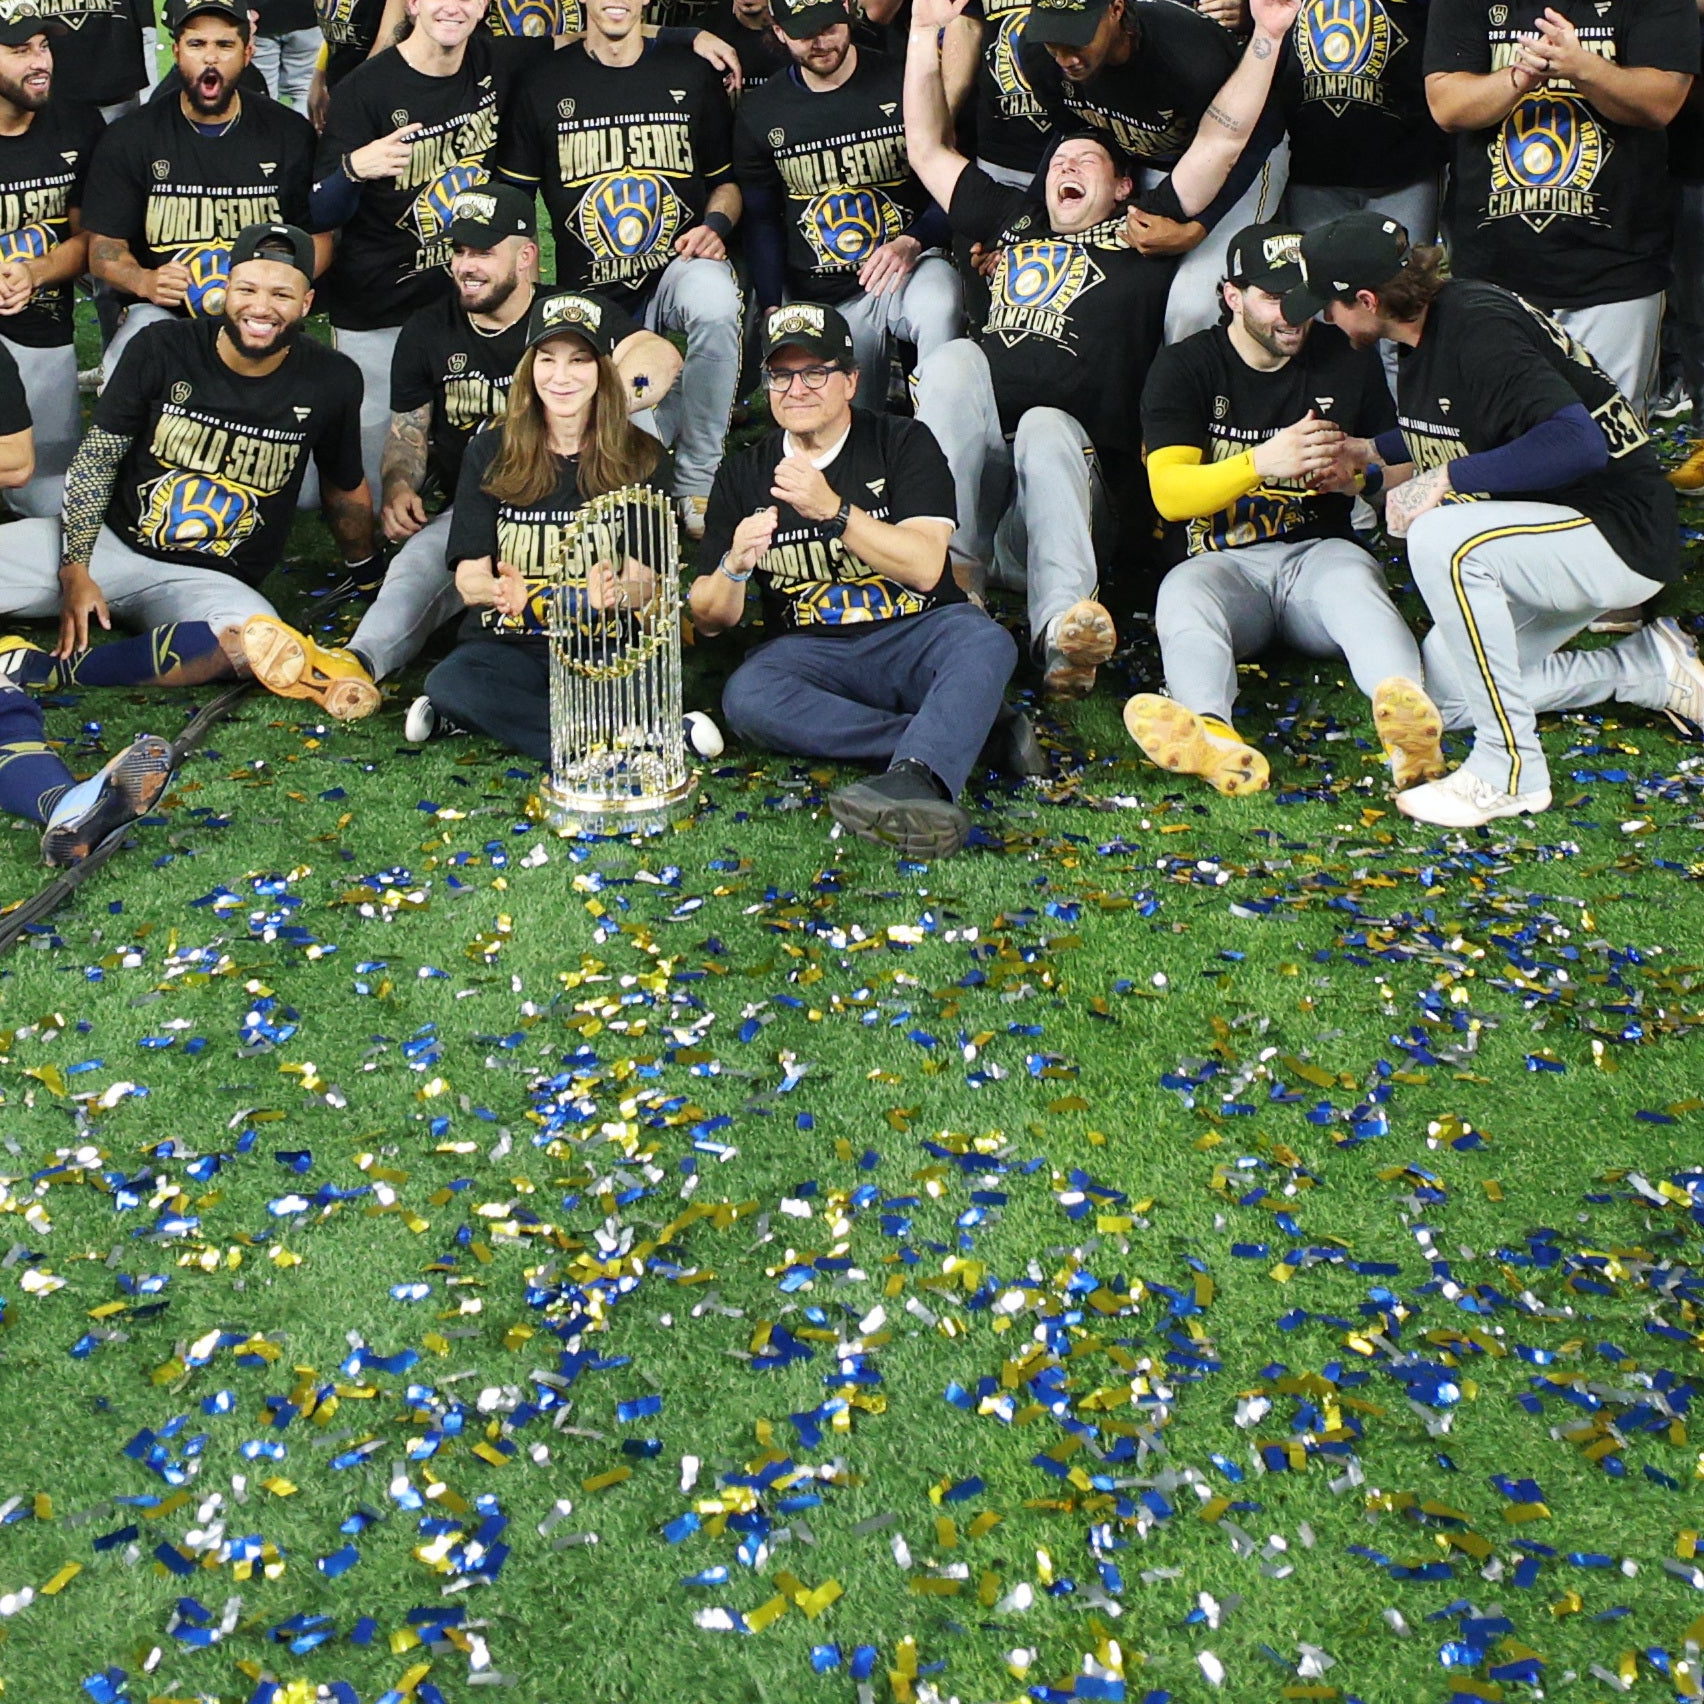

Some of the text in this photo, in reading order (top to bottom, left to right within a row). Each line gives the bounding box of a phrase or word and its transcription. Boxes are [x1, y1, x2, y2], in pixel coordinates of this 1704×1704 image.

[1302, 77, 1385, 105] CHAMPIONS
[558, 125, 694, 176] WORLD SERIES
[1570, 120, 1601, 191] BREWERS
[1489, 188, 1594, 216] CHAMPIONS
[543, 294, 602, 323] CHAMPIONS
[767, 305, 827, 336] CHAMPIONS
